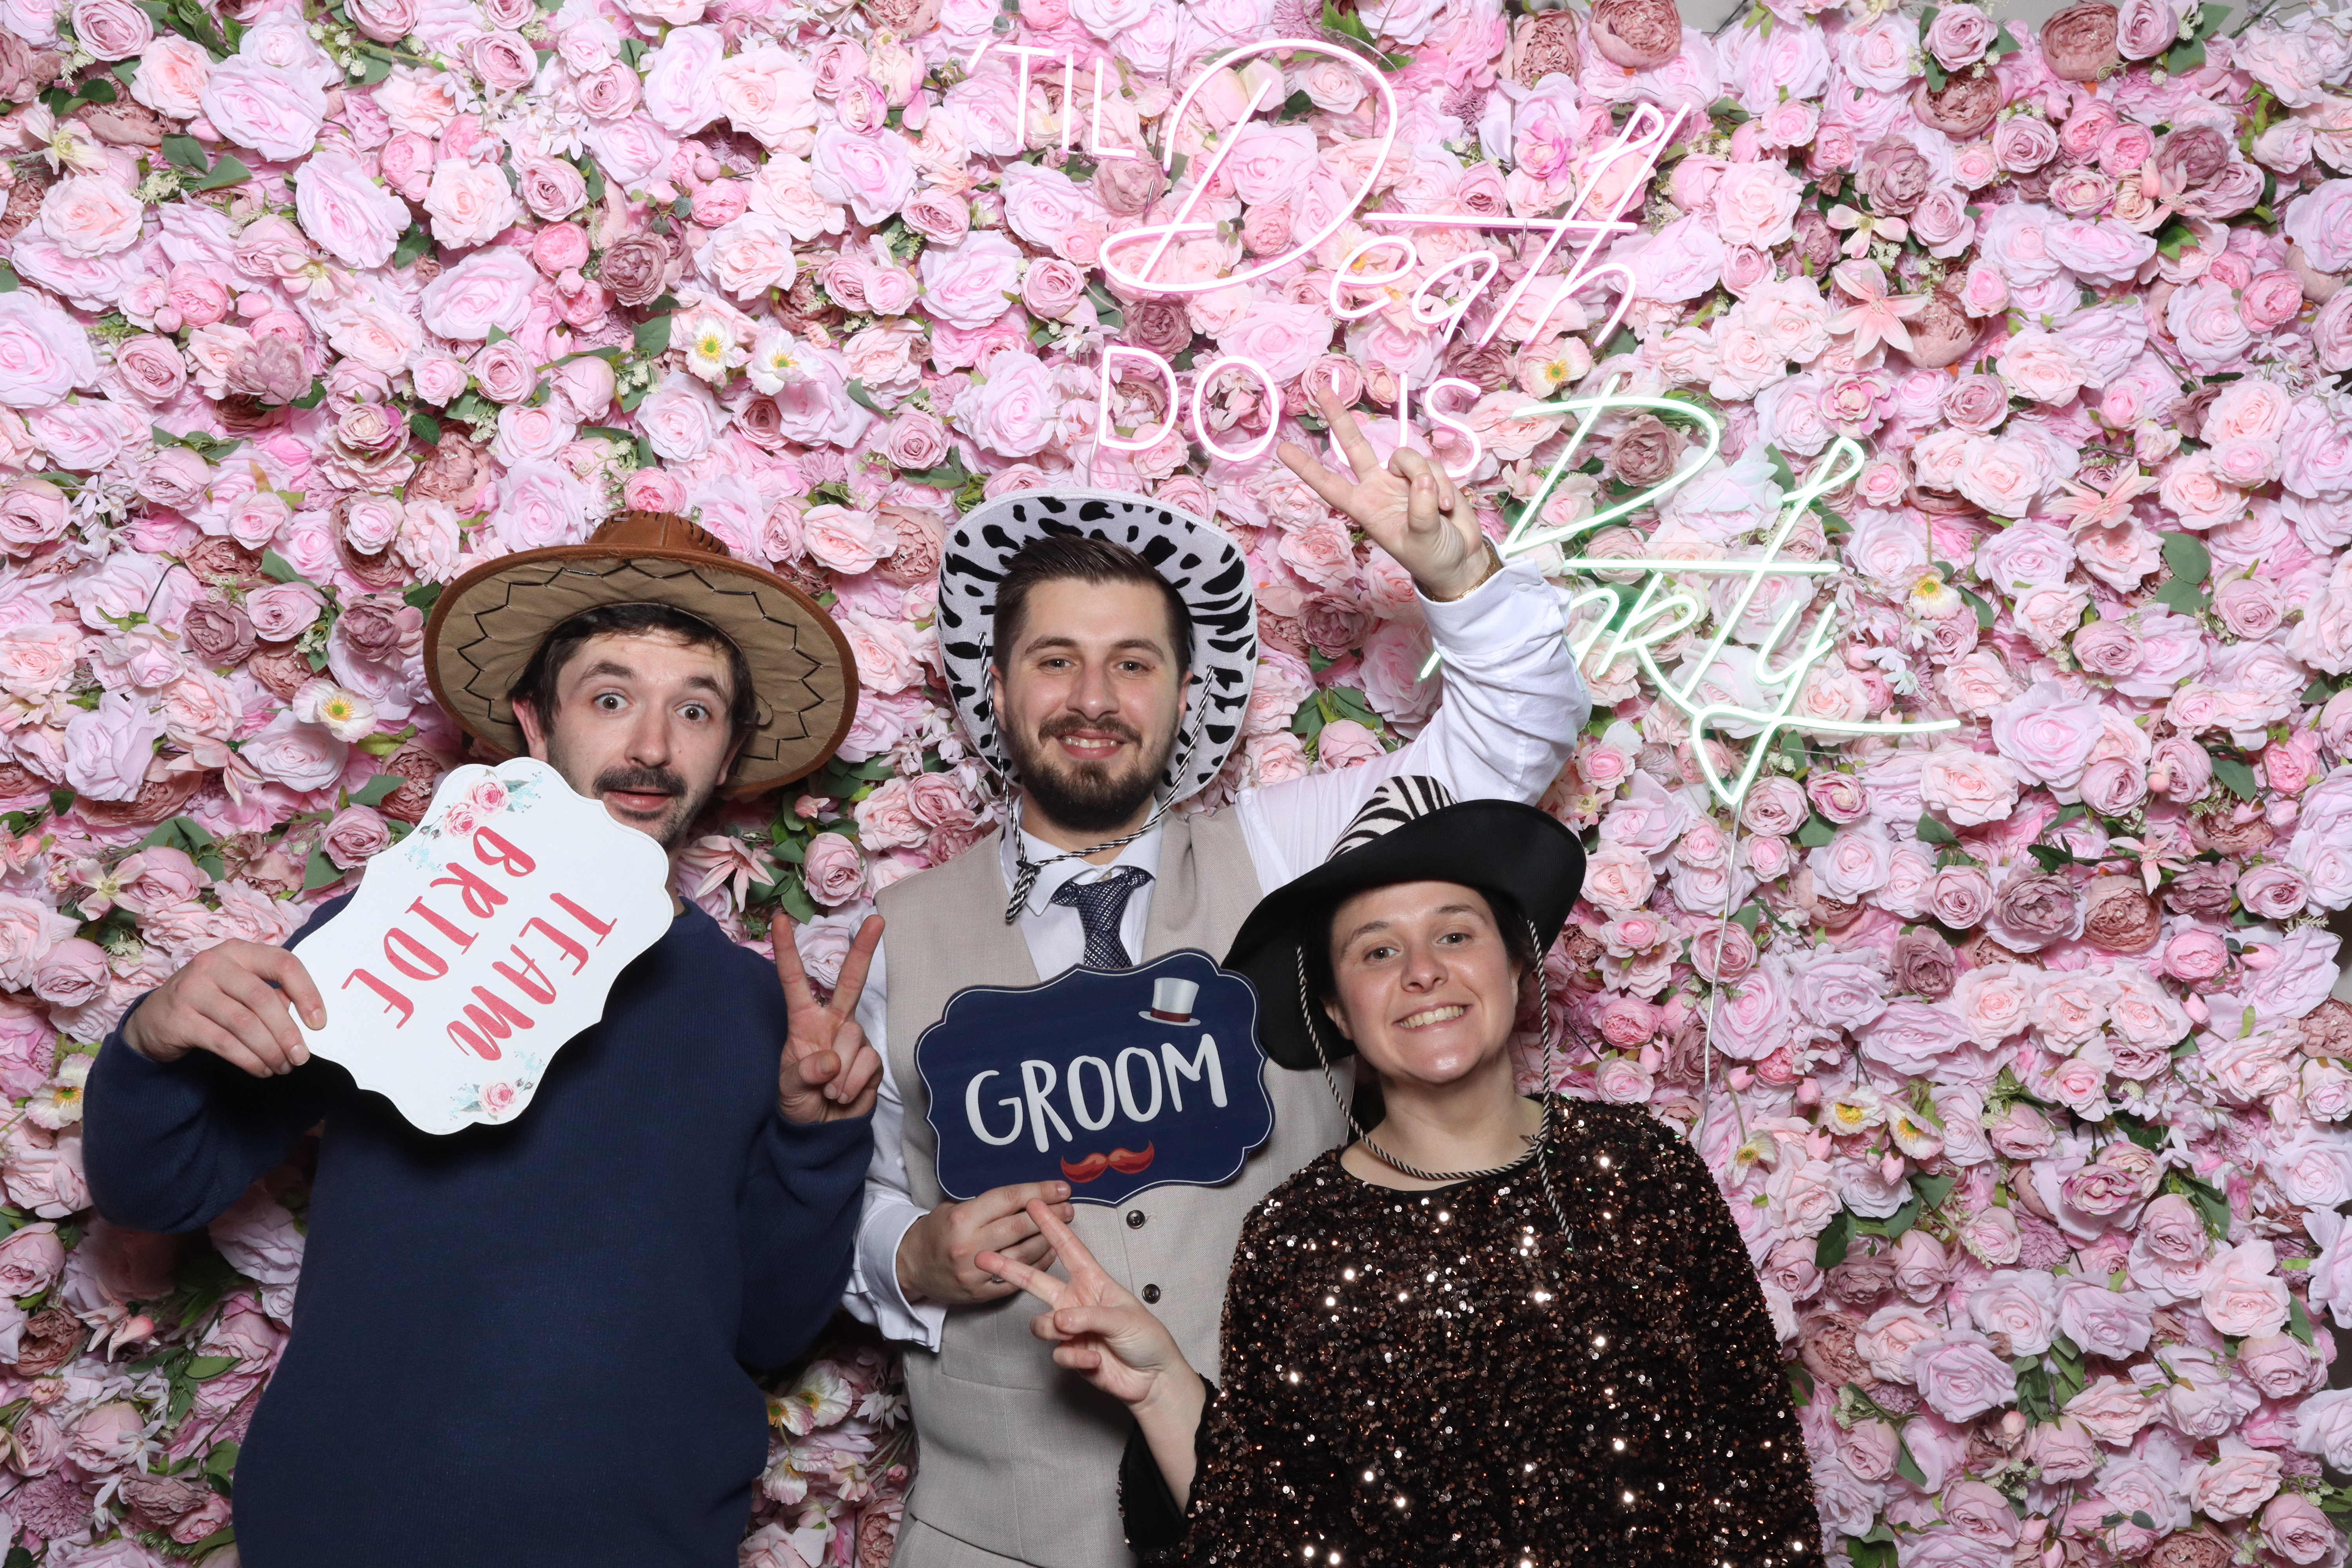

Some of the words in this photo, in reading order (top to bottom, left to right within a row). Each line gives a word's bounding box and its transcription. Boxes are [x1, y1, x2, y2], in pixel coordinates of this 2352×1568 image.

[967, 38, 1138, 159] 'TIL
[1098, 38, 1691, 348] Death
[1098, 344, 1280, 462] DO
[1330, 366, 1482, 478] US
[341, 826, 536, 1029] BRIDE
[446, 893, 617, 1061] TEAM
[965, 1033, 1228, 1152] GROOM
